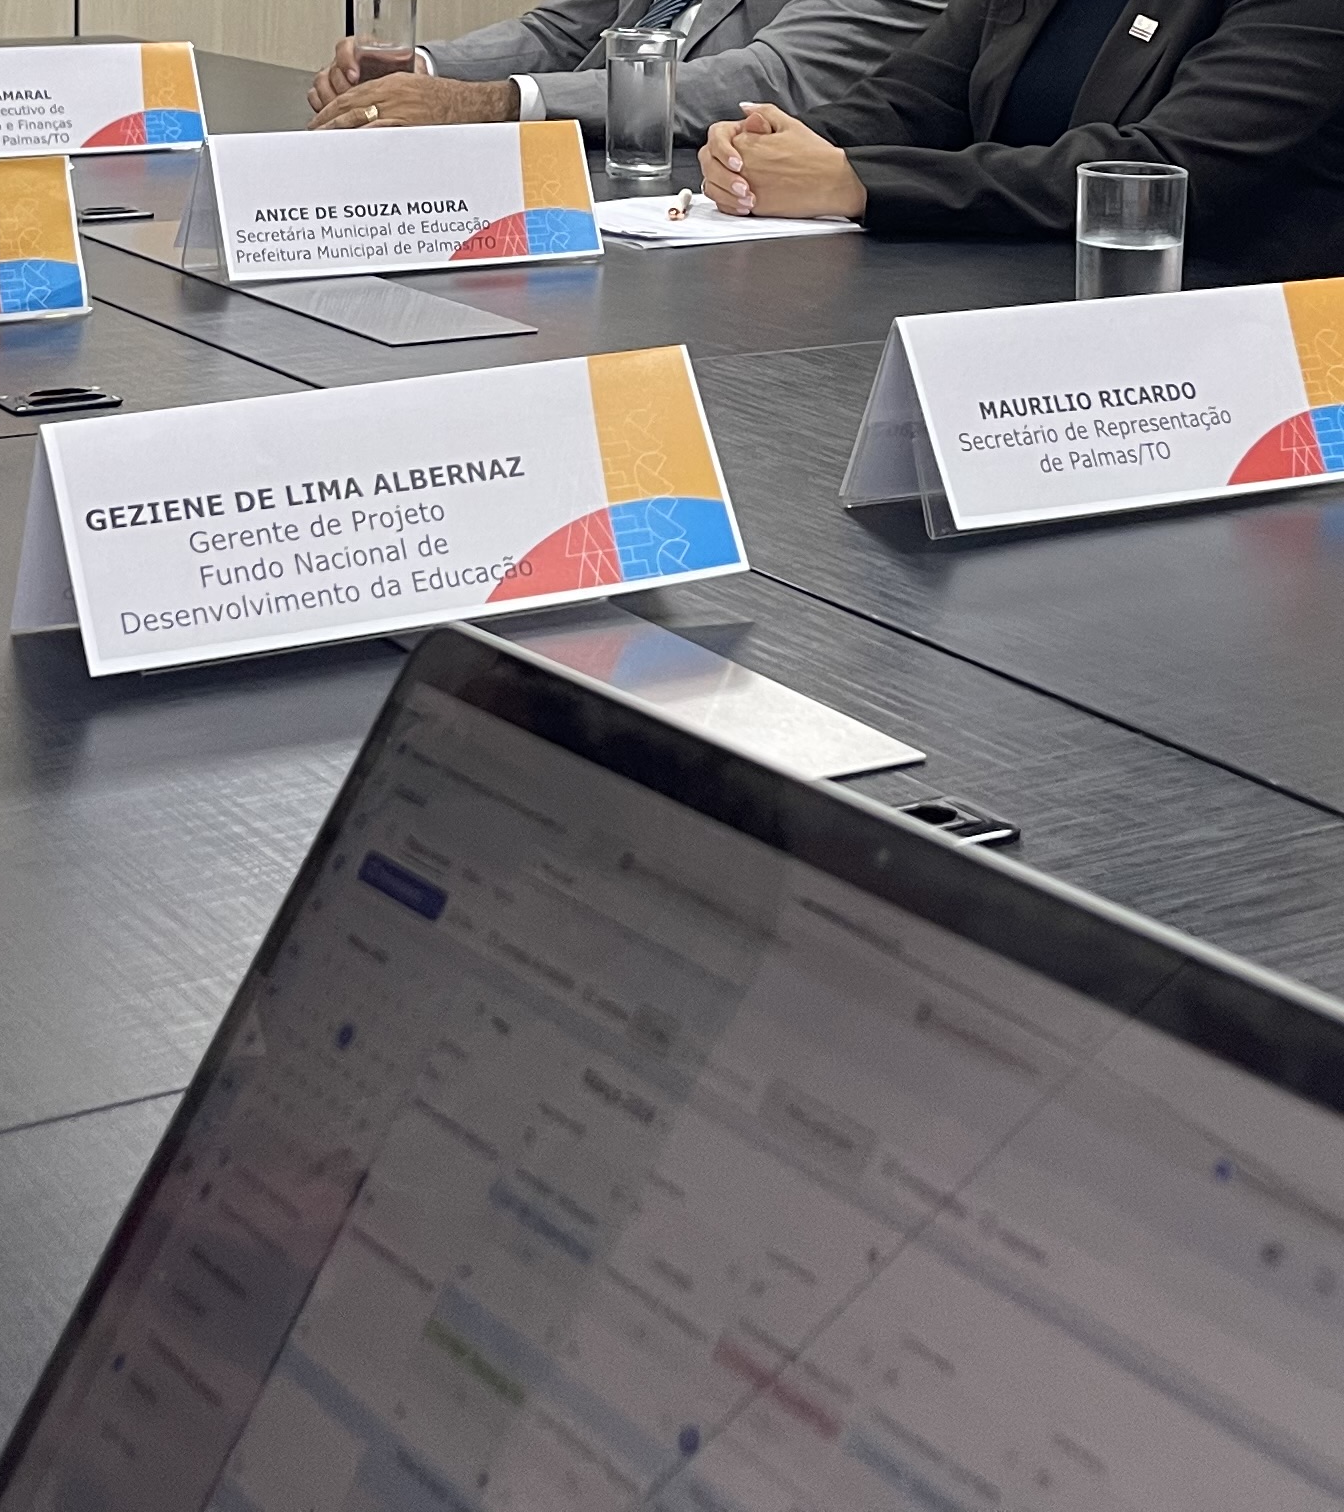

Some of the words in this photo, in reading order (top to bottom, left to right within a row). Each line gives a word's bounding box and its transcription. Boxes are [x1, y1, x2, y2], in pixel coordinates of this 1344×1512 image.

[7, 123, 13, 131] e
[18, 119, 72, 131] Finanças
[50, 104, 65, 114] de
[2, 133, 70, 146] Palmas/TO
[255, 208, 310, 222] ANICE
[315, 206, 337, 219] DE
[344, 203, 402, 218] SOUZA
[407, 200, 468, 214] MOURA
[236, 225, 315, 243] Secretária
[321, 221, 392, 239] Municipal
[398, 221, 415, 235] de
[421, 217, 490, 234] Educação
[236, 245, 311, 263] Prefeitura
[318, 241, 388, 260] Municipal
[394, 241, 412, 255] de
[418, 236, 496, 253] Palmas/TO
[978, 392, 1091, 420] MAURILIO
[1099, 381, 1196, 409] RICARDO
[958, 423, 1059, 452] Secretário
[1065, 422, 1089, 441] de
[1094, 406, 1231, 439] Representação
[1040, 454, 1064, 474] de
[1069, 441, 1170, 471] Palmas/TO
[86, 493, 225, 532] GEZIENE
[235, 489, 275, 513] DE
[286, 477, 363, 506] LIMA
[373, 457, 525, 495] ALBERNAZ
[190, 519, 300, 555] Gerente
[310, 514, 342, 536] de
[353, 502, 445, 535] Projeto
[200, 558, 284, 588] Fundo
[295, 536, 409, 575] Nacional
[418, 533, 450, 556] de
[120, 581, 361, 635] Desenvolvimento
[371, 576, 402, 599] da
[412, 556, 534, 594] Educação
